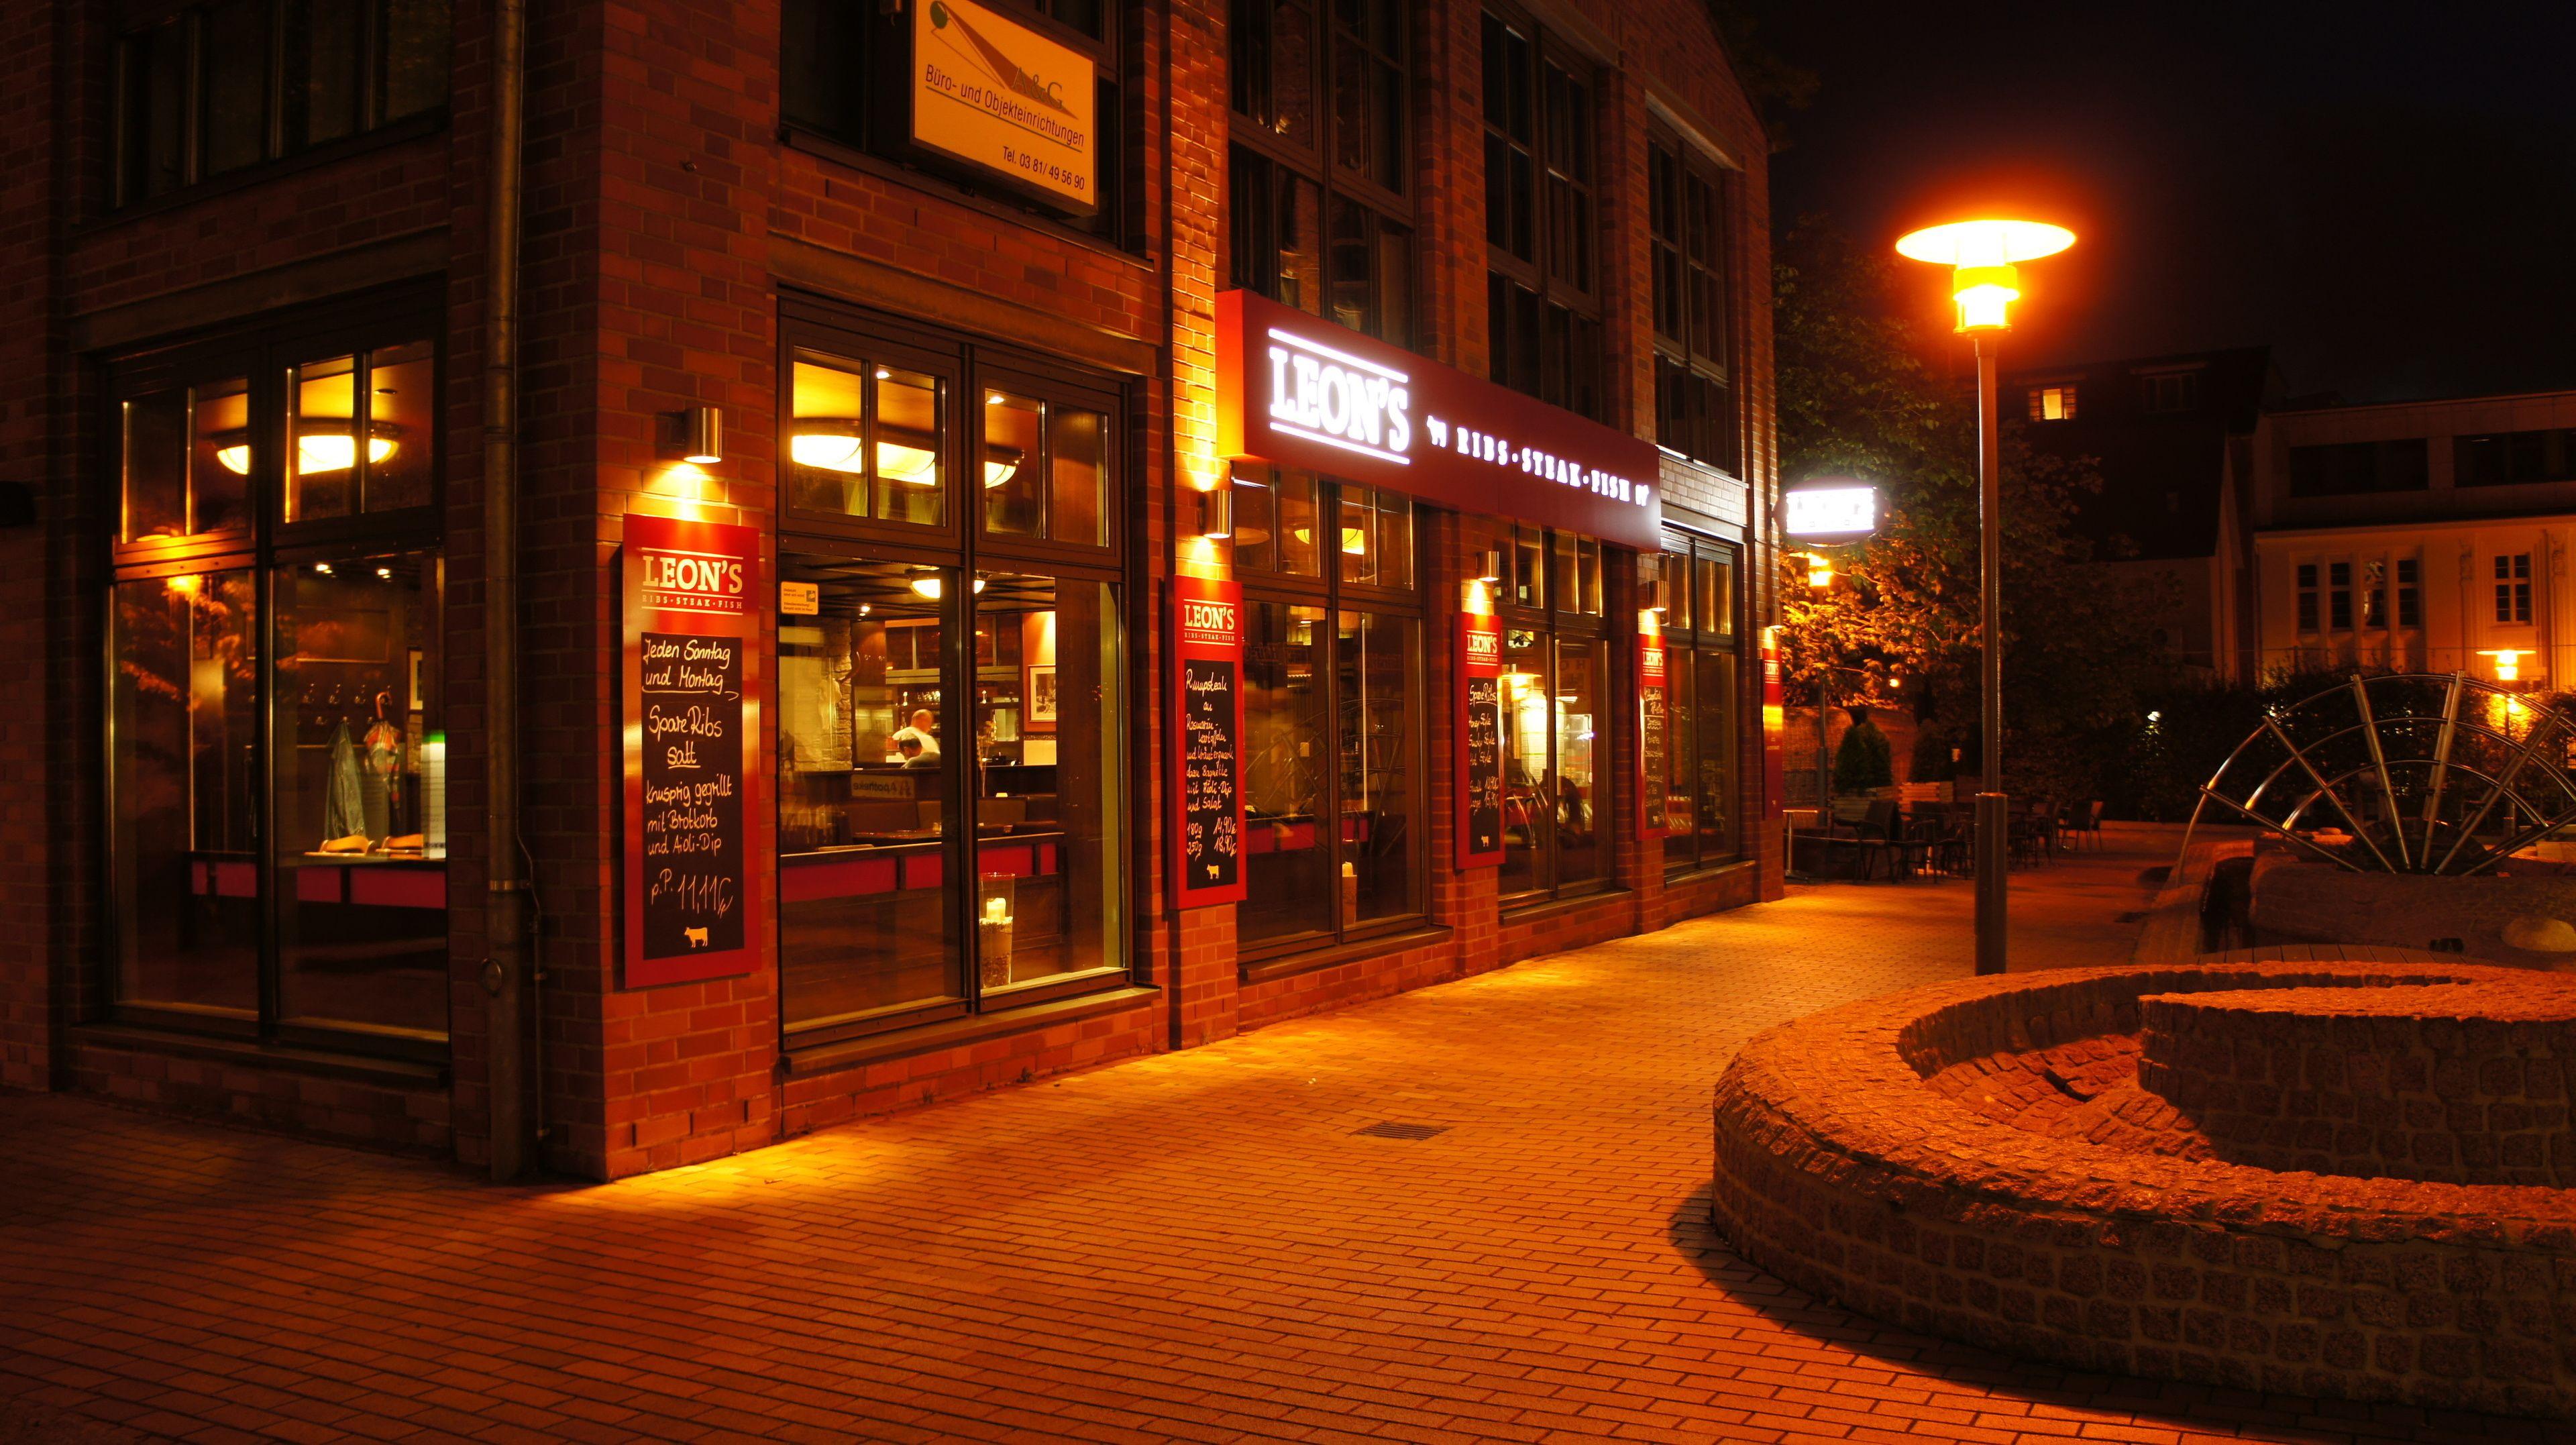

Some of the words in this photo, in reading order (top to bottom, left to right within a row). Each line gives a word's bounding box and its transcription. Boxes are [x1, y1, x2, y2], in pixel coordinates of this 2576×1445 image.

[925, 64, 957, 92] Büro-
[961, 82, 981, 104] und
[984, 90, 1085, 148] Objekteinrichtungen
[1002, 146, 1017, 165] Tel.
[1019, 153, 1031, 169] 03
[1048, 164, 1059, 182] 49
[1061, 168, 1072, 186] 56
[1073, 173, 1085, 191] 90
[1269, 346, 1409, 452] LEON'S
[642, 555, 743, 594] LEON'S
[1184, 604, 1235, 631] LEON'S
[643, 639, 680, 665] Jeden
[684, 639, 731, 670] Sonntag
[1466, 634, 1498, 654] LEON'S
[645, 665, 672, 687] und
[679, 666, 724, 694] Montag
[695, 773, 733, 806] gegrillt
[647, 811, 667, 833] mit
[668, 807, 718, 831] Brotkorb
[648, 837, 669, 855] und
